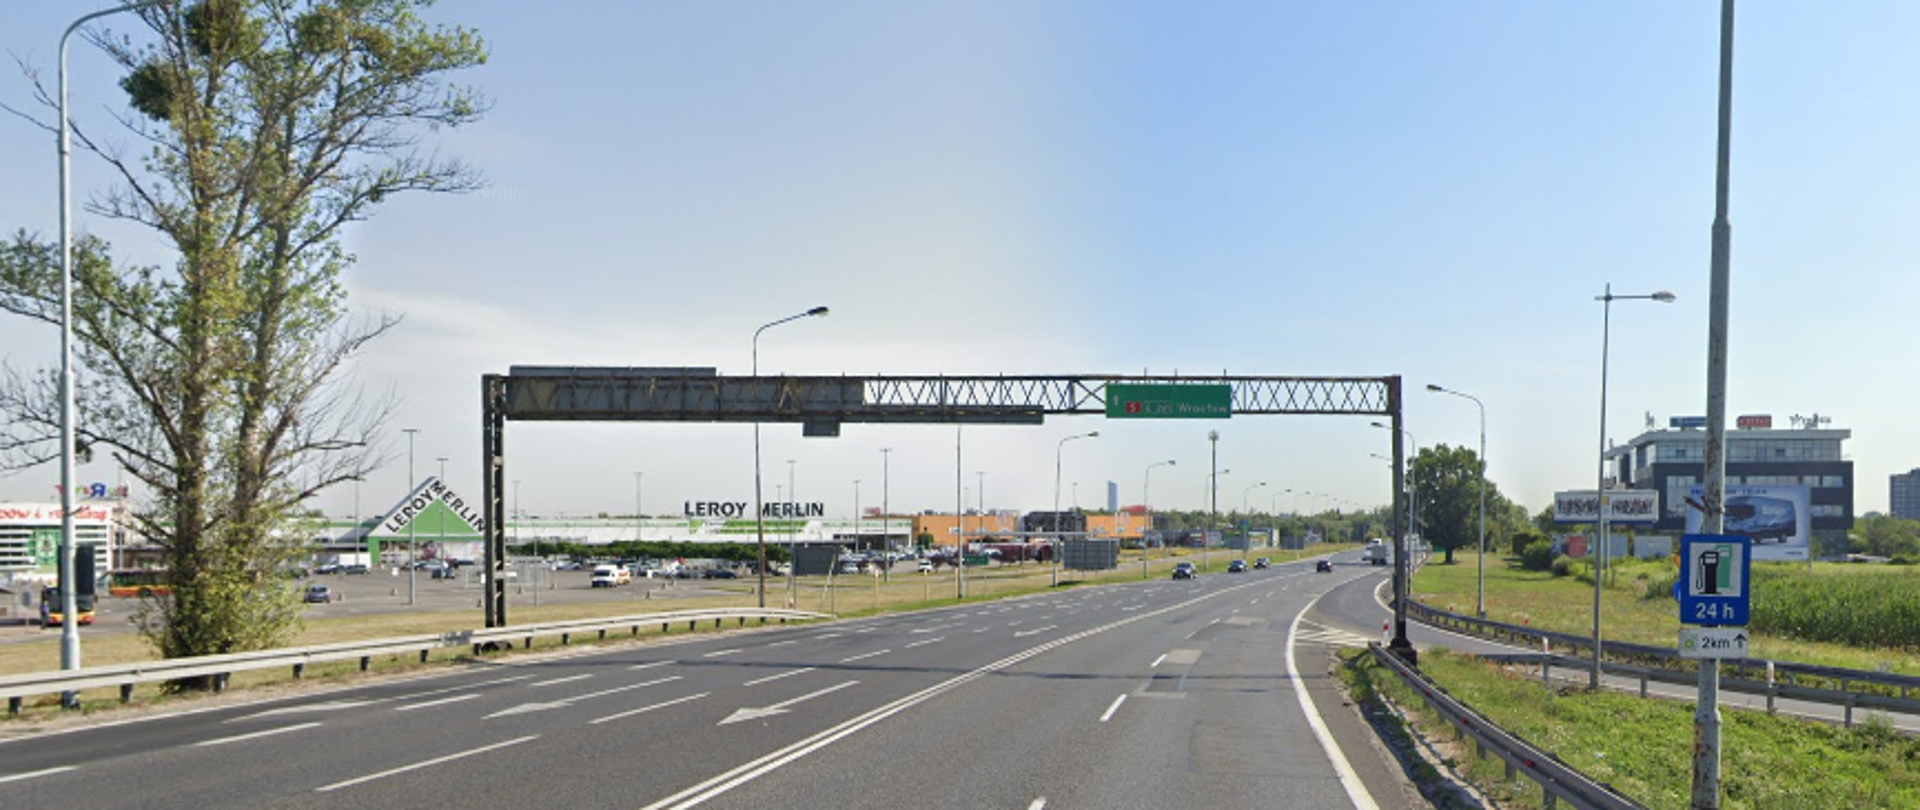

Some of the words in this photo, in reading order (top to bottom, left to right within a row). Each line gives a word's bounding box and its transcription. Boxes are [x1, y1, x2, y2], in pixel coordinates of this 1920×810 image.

[385, 489, 433, 532] LEROY
[430, 480, 485, 532] MERLIN
[684, 501, 748, 517] LEROY
[760, 502, 824, 517] MERLIN
[1695, 603, 1717, 618] 24
[1723, 603, 1734, 618] h
[1701, 636, 1730, 649] 2km
